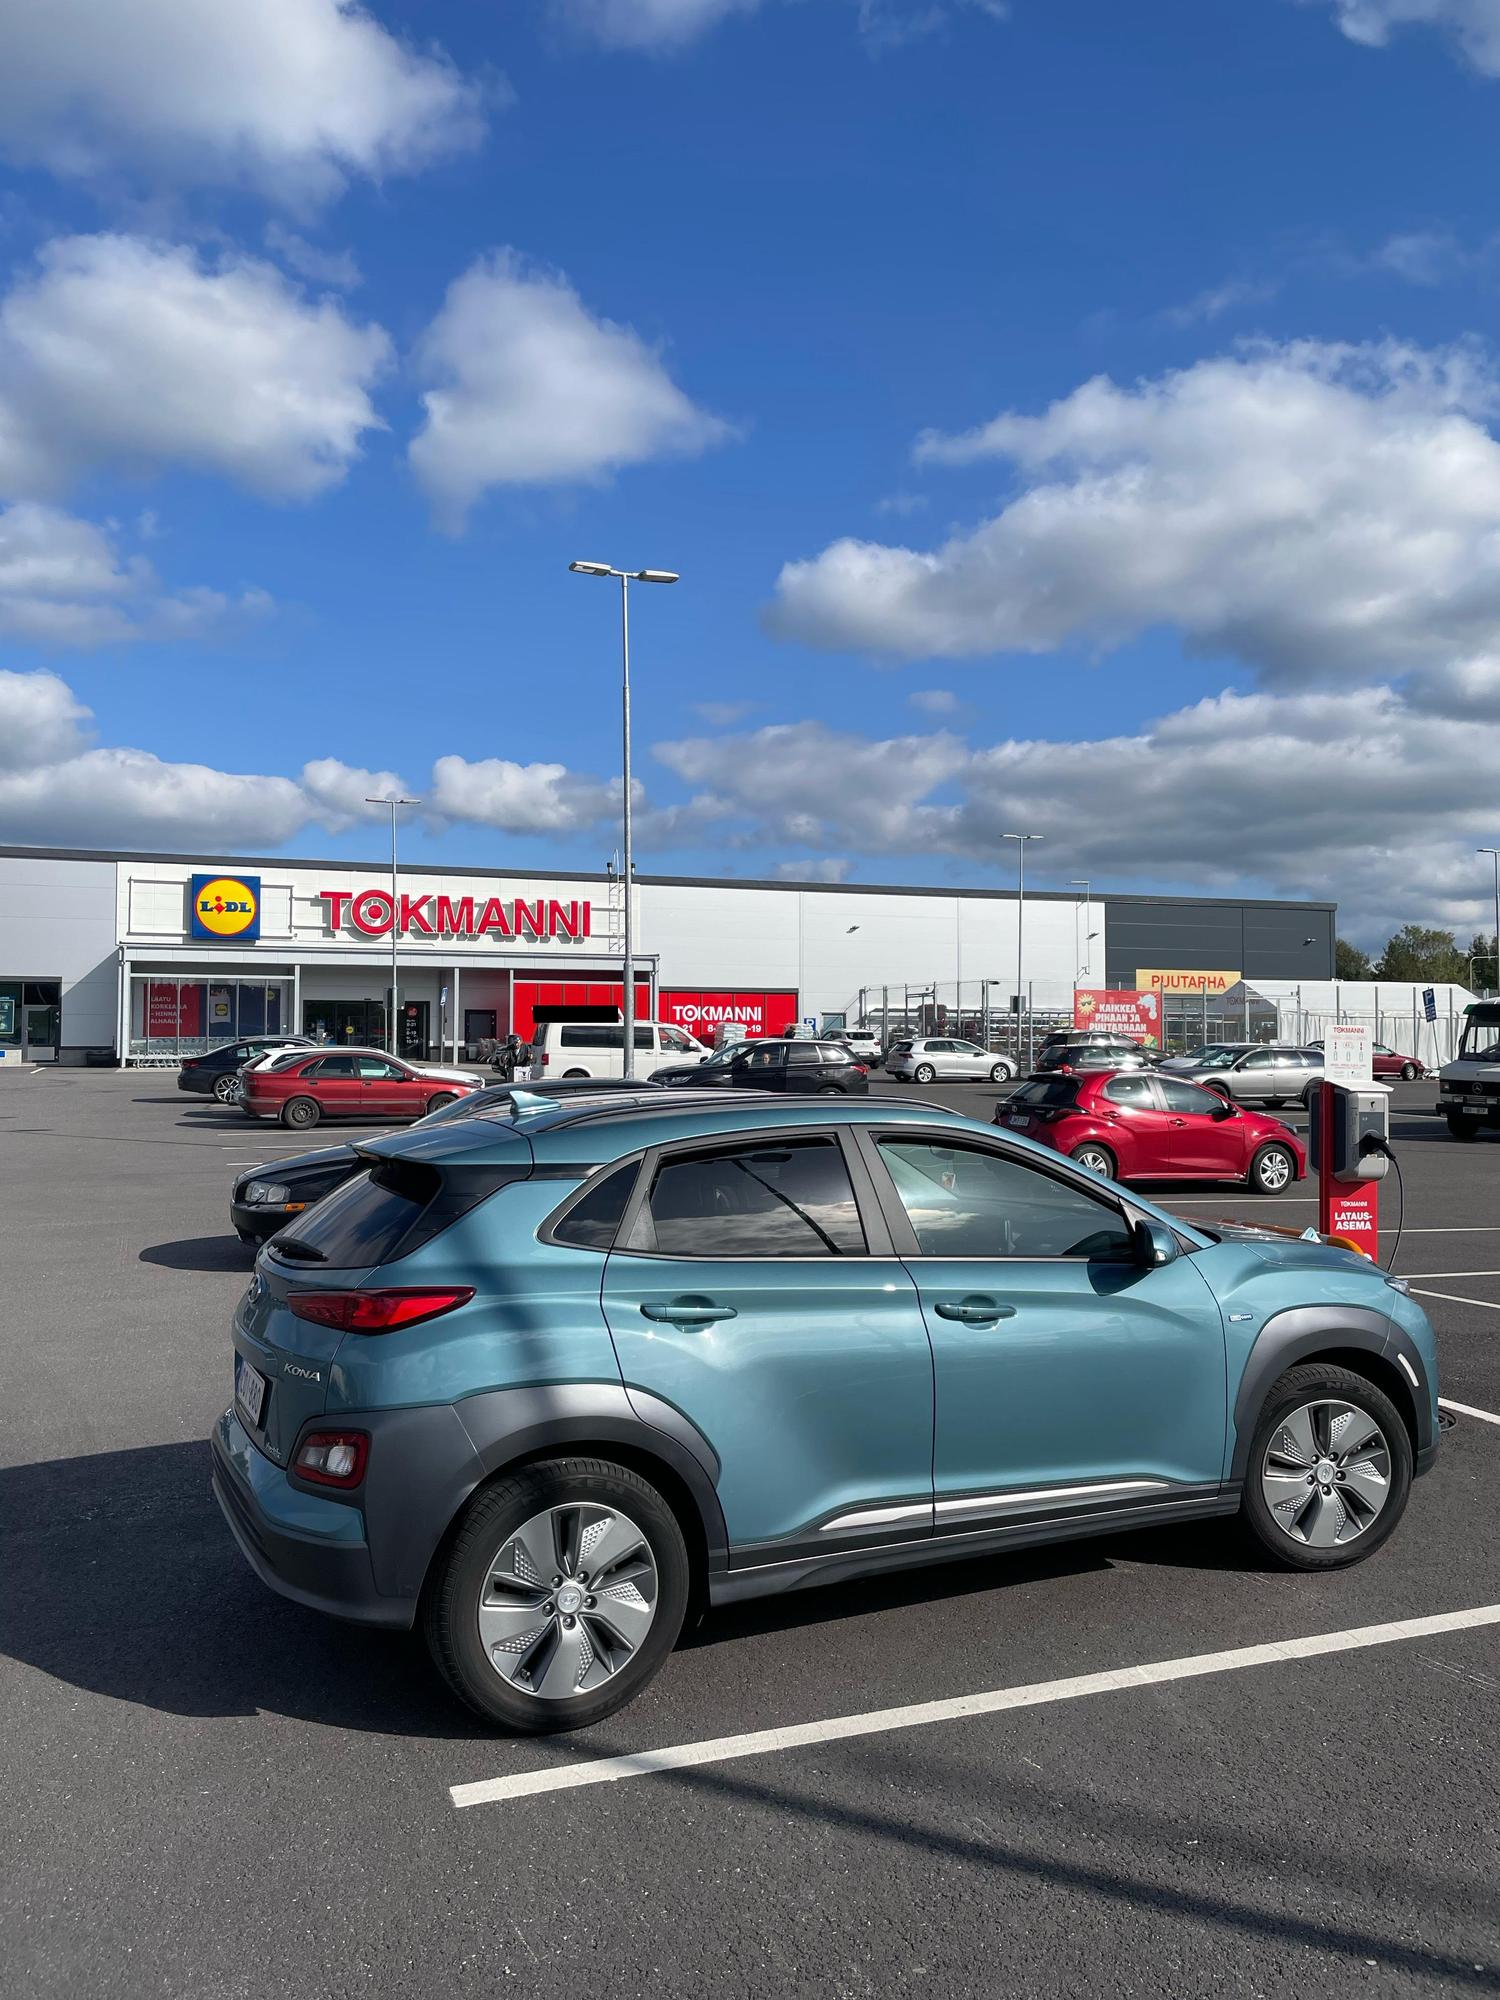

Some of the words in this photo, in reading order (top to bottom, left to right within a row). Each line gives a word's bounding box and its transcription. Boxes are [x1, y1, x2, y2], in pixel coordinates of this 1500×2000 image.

[320, 889, 591, 938] TOKMANNI
[1151, 975, 1226, 988] PUUTARHA
[1425, 991, 1433, 1004] P
[672, 1005, 762, 1021] TOKMANNI
[1099, 1004, 1136, 1013] KAIKKEA
[1095, 1013, 1128, 1022] PIHAAN
[1130, 1014, 1141, 1022] JA
[1089, 1023, 1147, 1032] PUUTARHAAN
[1334, 1211, 1373, 1221] LATAUS-
[1335, 1221, 1372, 1230] ASEMA
[283, 1363, 321, 1382] KONA
